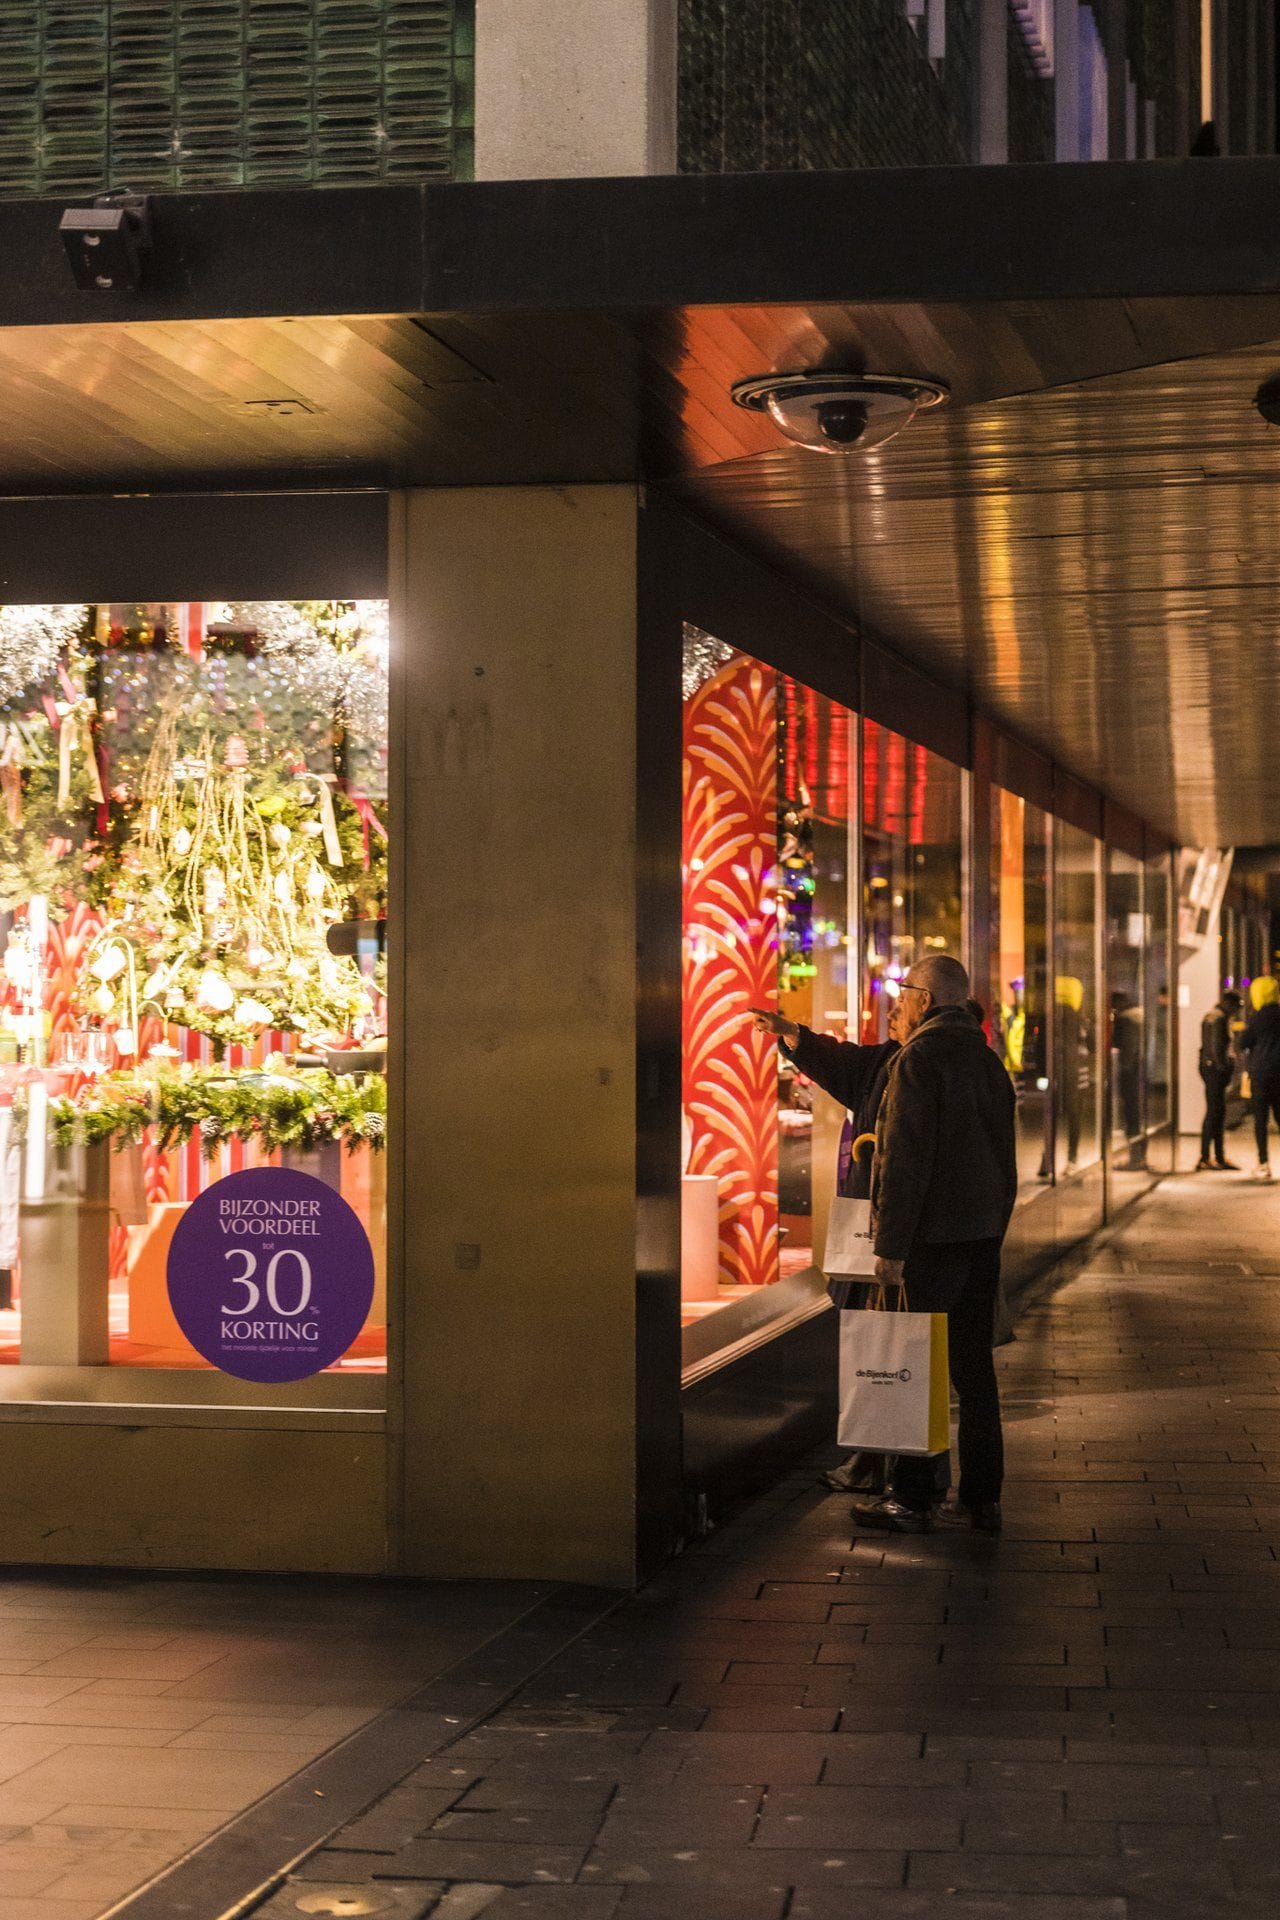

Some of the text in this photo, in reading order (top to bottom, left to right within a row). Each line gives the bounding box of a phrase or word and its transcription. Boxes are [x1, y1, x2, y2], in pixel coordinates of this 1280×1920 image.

[219, 1199, 321, 1217] BIJZONDER
[219, 1219, 321, 1235] VOORDEEL
[262, 1241, 275, 1250] tot
[221, 1321, 319, 1341] KORTING
